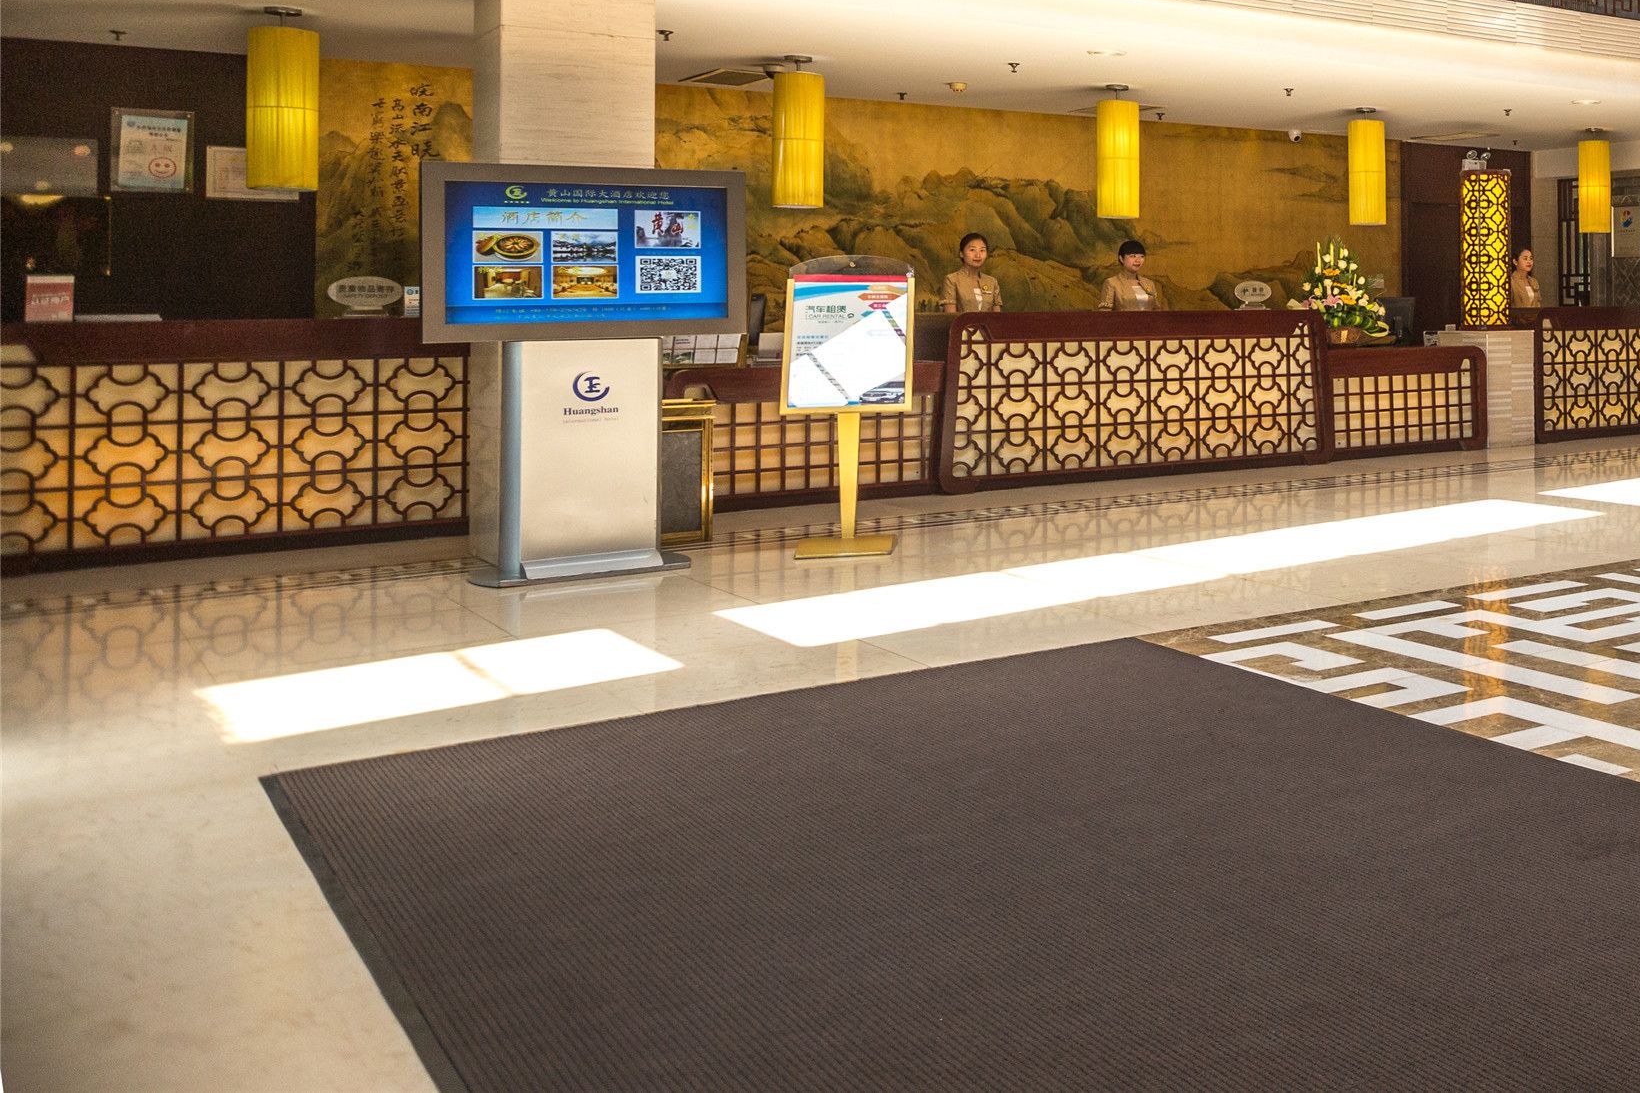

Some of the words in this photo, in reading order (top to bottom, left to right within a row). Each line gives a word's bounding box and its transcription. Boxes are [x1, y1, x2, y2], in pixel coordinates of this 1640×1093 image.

[546, 188, 670, 200] 黄山国际大酒店欢迎您
[501, 210, 588, 225] 酒店简介
[651, 211, 684, 235] 黄山
[805, 305, 847, 313] 汽车租赁
[563, 405, 619, 416] Huangshan
